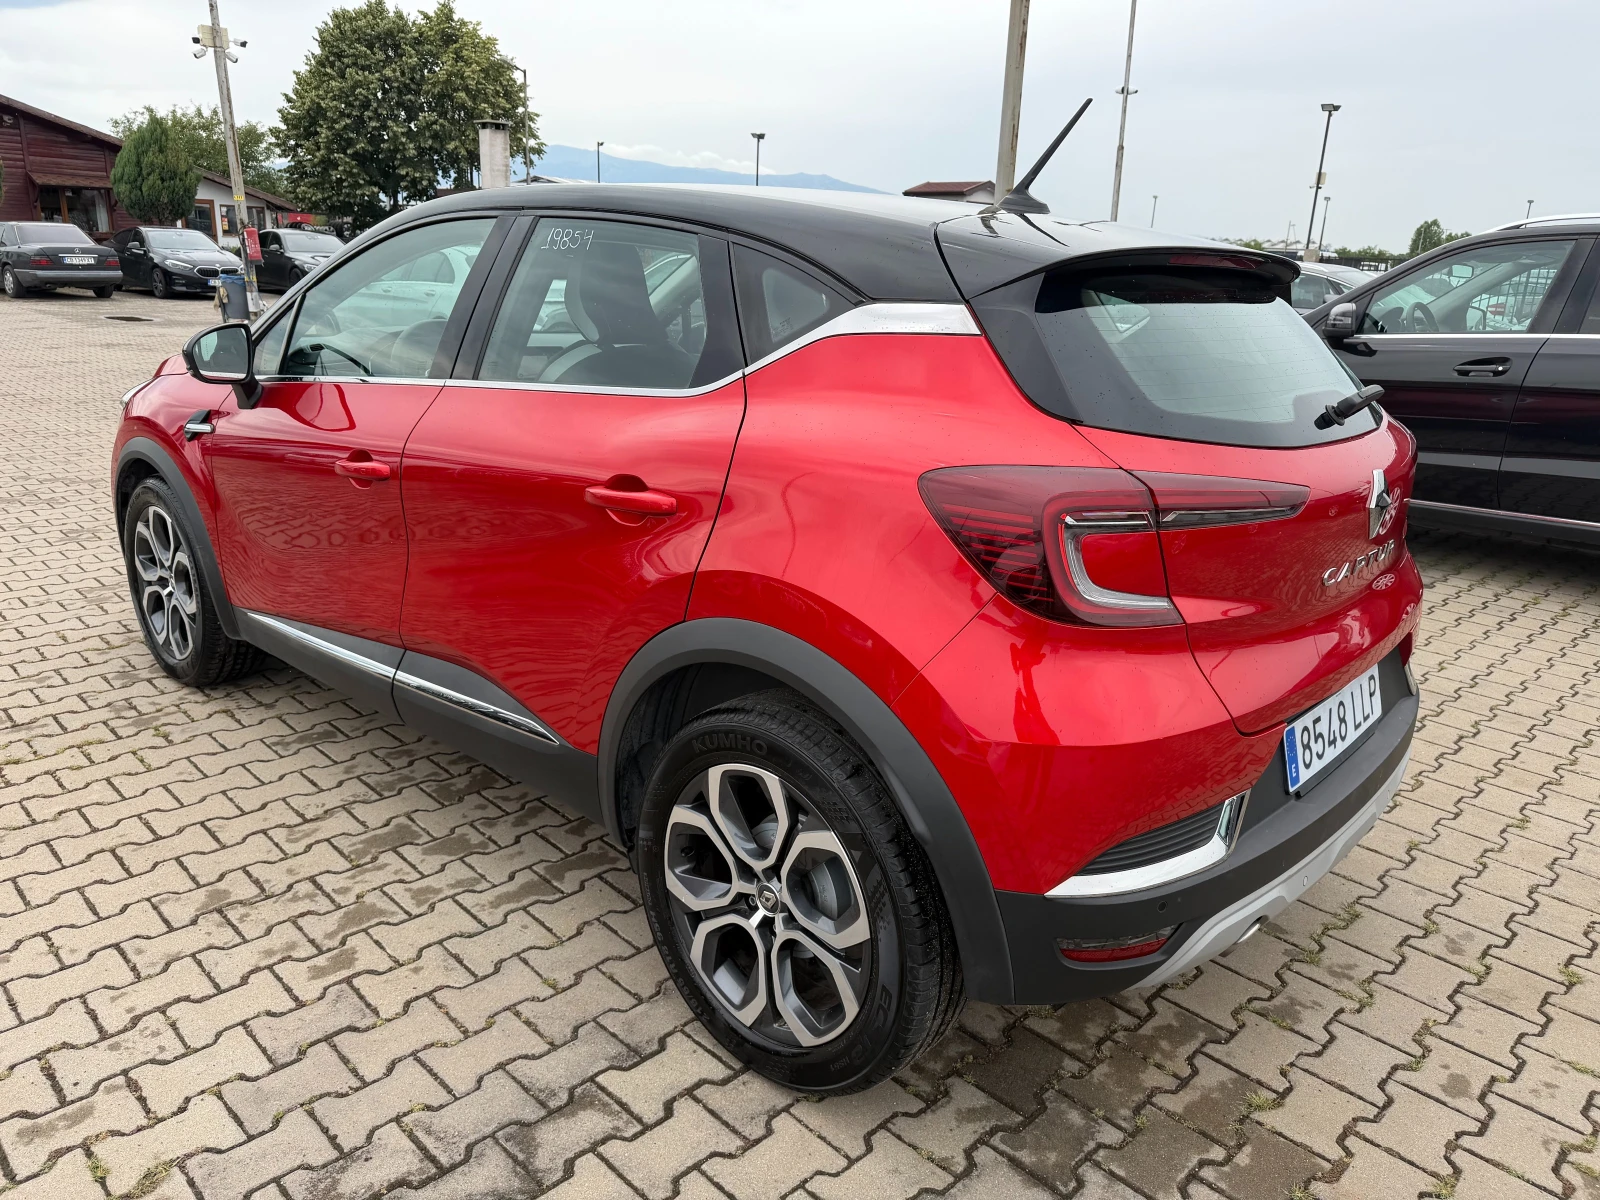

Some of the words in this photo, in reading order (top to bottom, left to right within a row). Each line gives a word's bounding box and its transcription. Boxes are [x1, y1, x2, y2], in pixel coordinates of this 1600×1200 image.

[541, 228, 594, 250] 19854
[1323, 539, 1395, 587] CAPTUR
[1300, 700, 1348, 770] 8548
[1352, 674, 1377, 732] LLP
[691, 733, 768, 757] KUMHO
[1291, 763, 1297, 777] E
